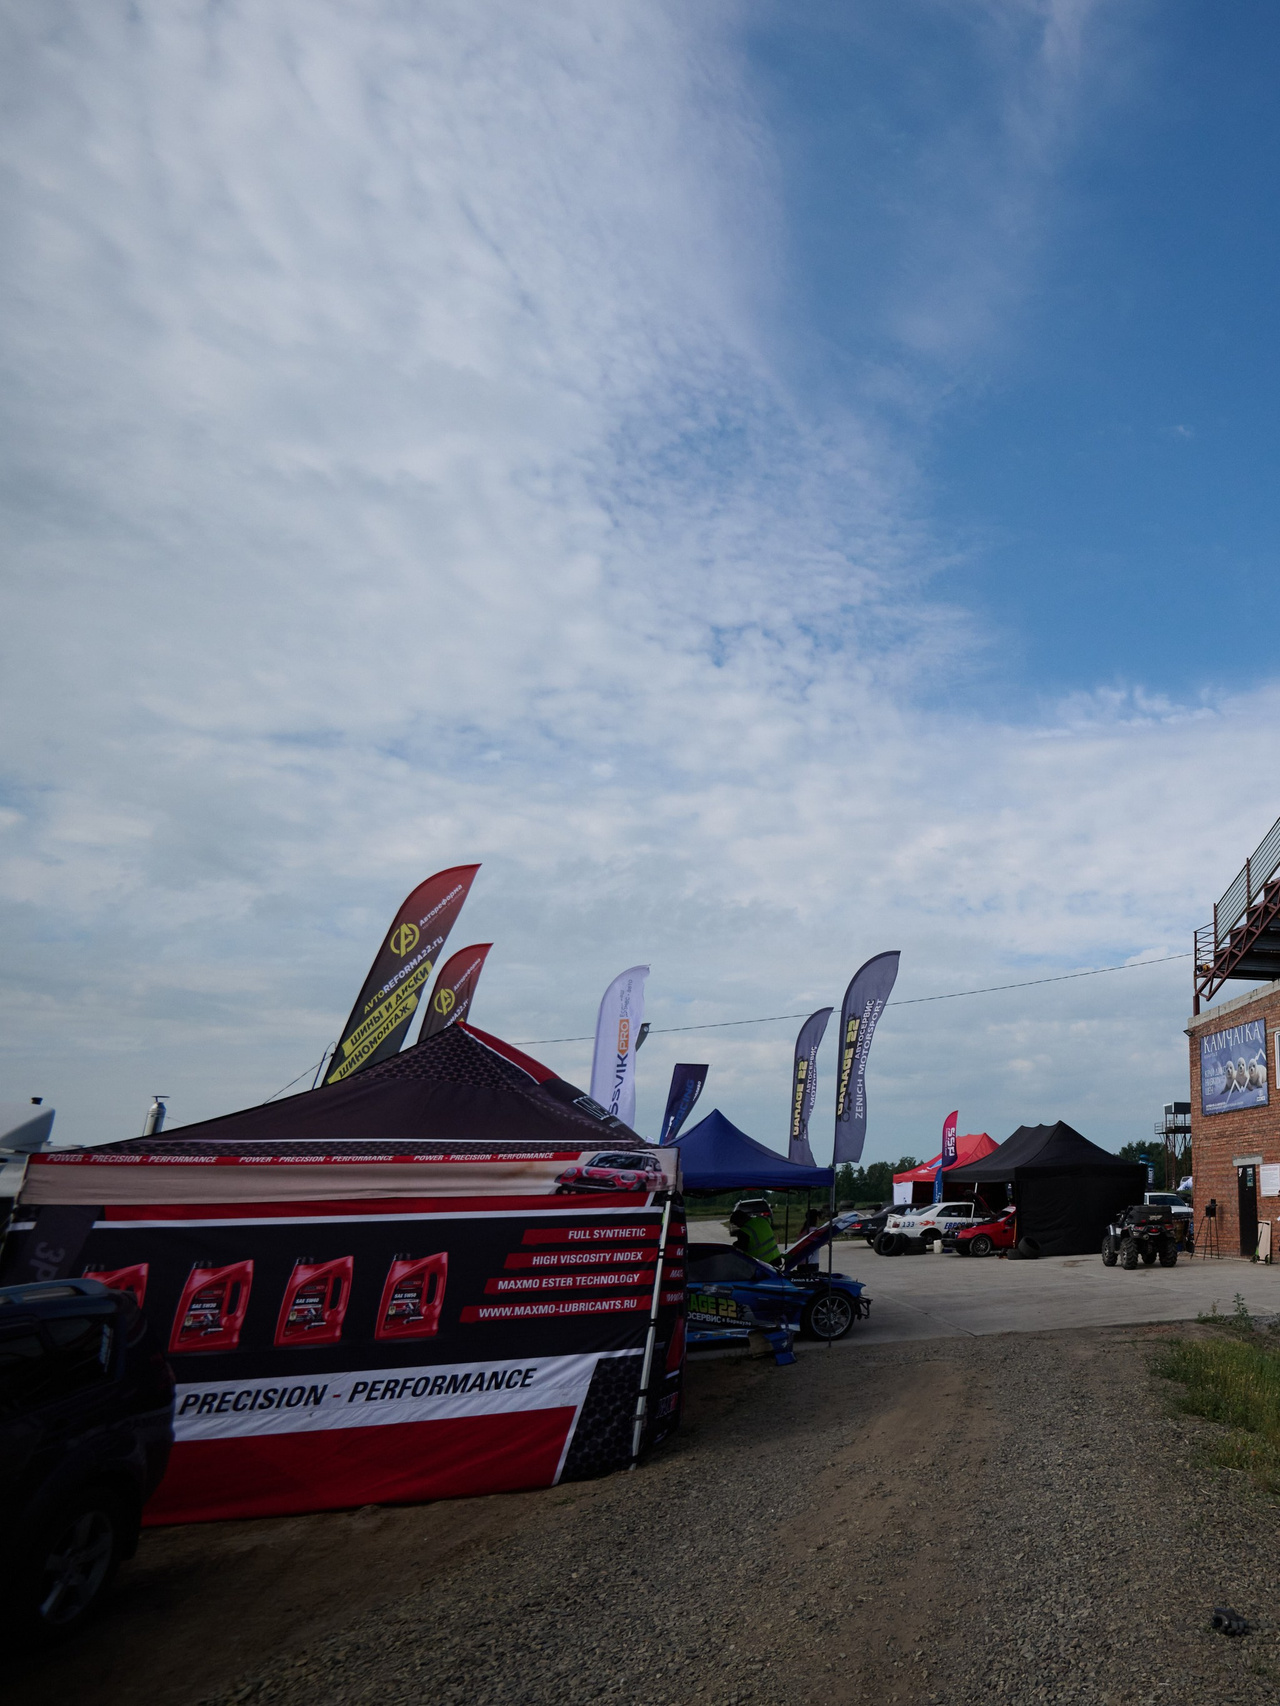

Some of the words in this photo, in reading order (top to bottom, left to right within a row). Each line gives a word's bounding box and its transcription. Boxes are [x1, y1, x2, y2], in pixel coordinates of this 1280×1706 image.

[419, 884, 463, 926] Автореформа
[350, 1007, 384, 1047] ШИНЫ
[395, 966, 430, 1003] ДИСКИ
[338, 1002, 411, 1078] ШИНОМОНТАЖ
[619, 1021, 629, 1050] PRO
[855, 999, 874, 1059] АВТОСЕРВИС
[1204, 1021, 1262, 1053] КАМЧАТКА
[797, 1060, 808, 1080] 22
[838, 1047, 854, 1116] GARAGE
[847, 1018, 860, 1043] 22
[855, 1079, 863, 1118] ZENICH
[859, 999, 883, 1075] MOTORSPORT
[47, 1154, 83, 1163] POWER
[89, 1154, 141, 1163] PRECISION
[148, 1155, 217, 1163] PERFORMANCE
[449, 1153, 491, 1161] PRECISION
[498, 1152, 554, 1160] PERFORMANCE
[568, 1229, 591, 1240] FULL
[593, 1228, 646, 1239] SYNTHETIC
[532, 1255, 558, 1265] HIGH
[560, 1253, 611, 1265] VISCOSITY
[613, 1251, 643, 1262] INDEX
[497, 1279, 540, 1290] MAXMO
[542, 1277, 573, 1288] ESTER
[575, 1274, 640, 1286] TECHNOLOGY
[478, 1299, 638, 1318] WWW.MAXMO-LUBRICANTS.RU
[718, 1298, 738, 1318] 22
[179, 1385, 328, 1416] PRECISION
[347, 1368, 537, 1404] PERFORMANCE
